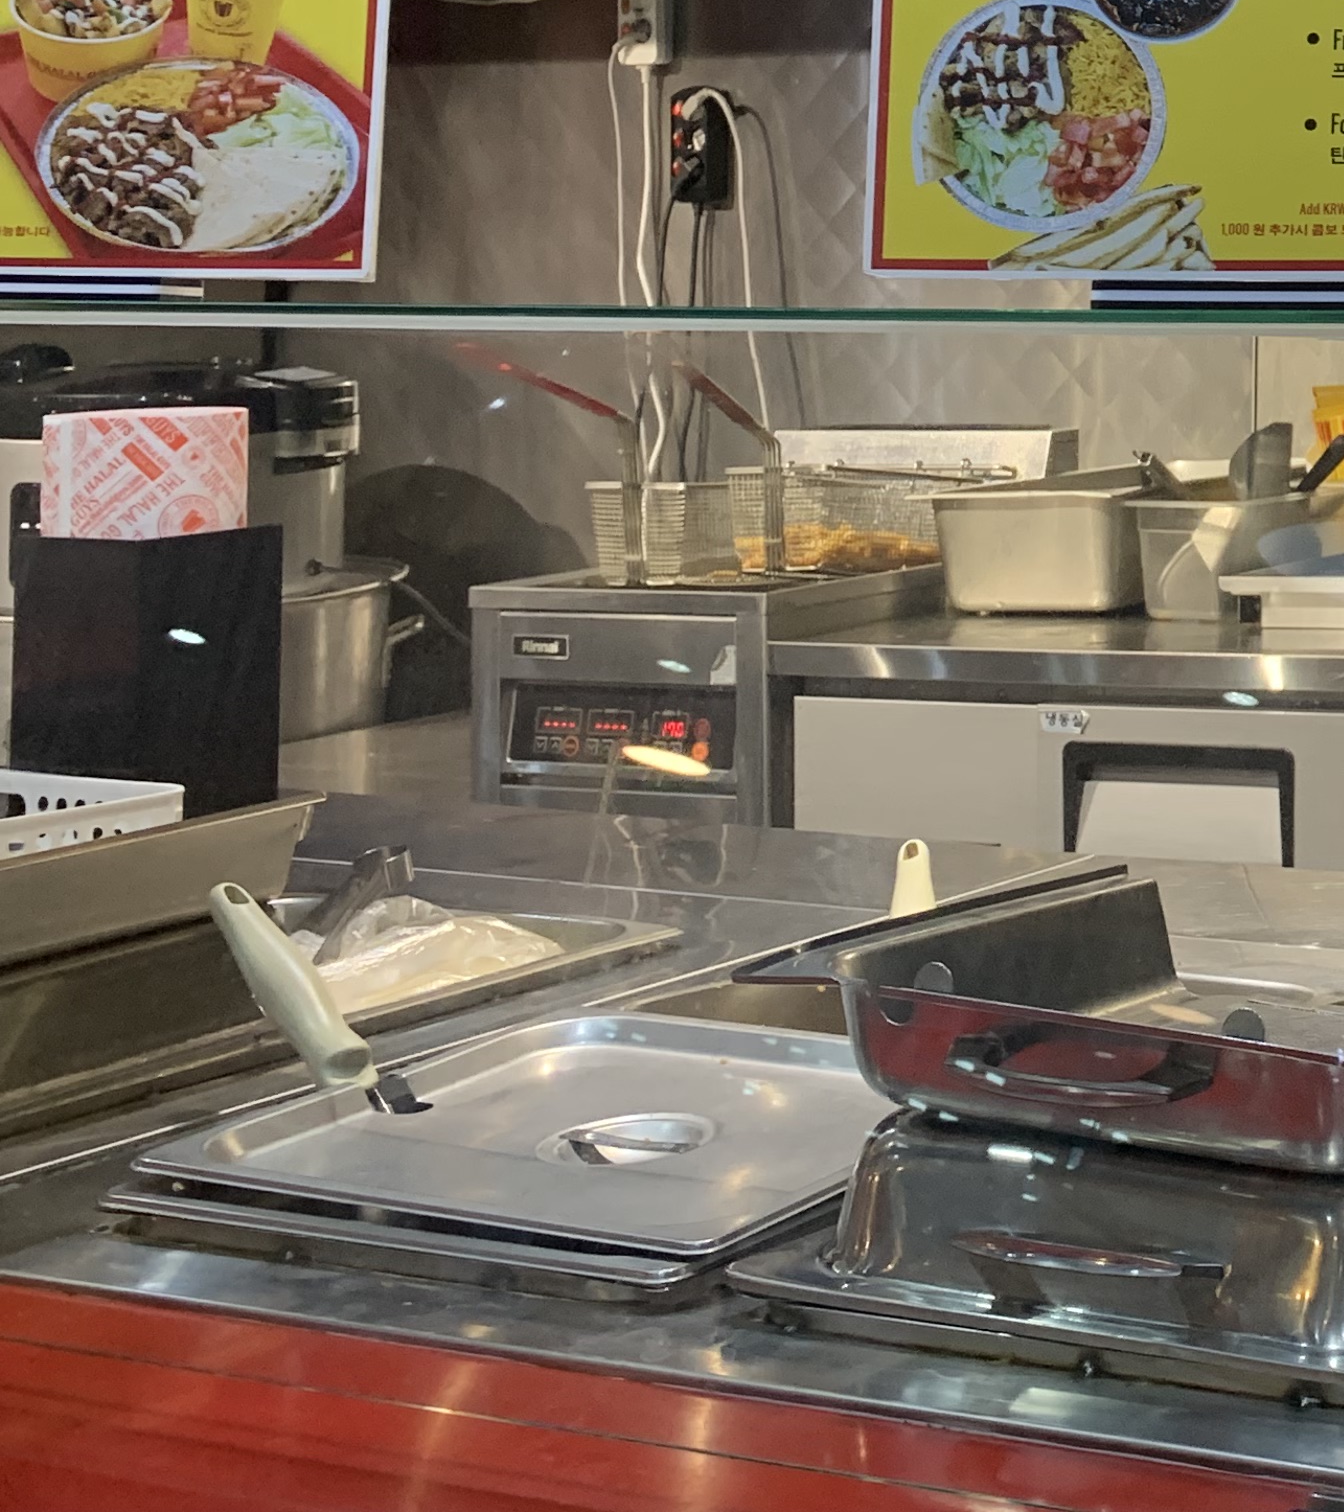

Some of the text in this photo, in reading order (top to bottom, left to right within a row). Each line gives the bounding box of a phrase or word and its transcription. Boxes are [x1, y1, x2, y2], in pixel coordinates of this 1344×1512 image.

[1299, 203, 1321, 216] Add
[0, 225, 50, 237] 능합니다
[1221, 223, 1250, 237] 1,000
[1253, 223, 1265, 236] 원
[1268, 223, 1308, 237] 추가시
